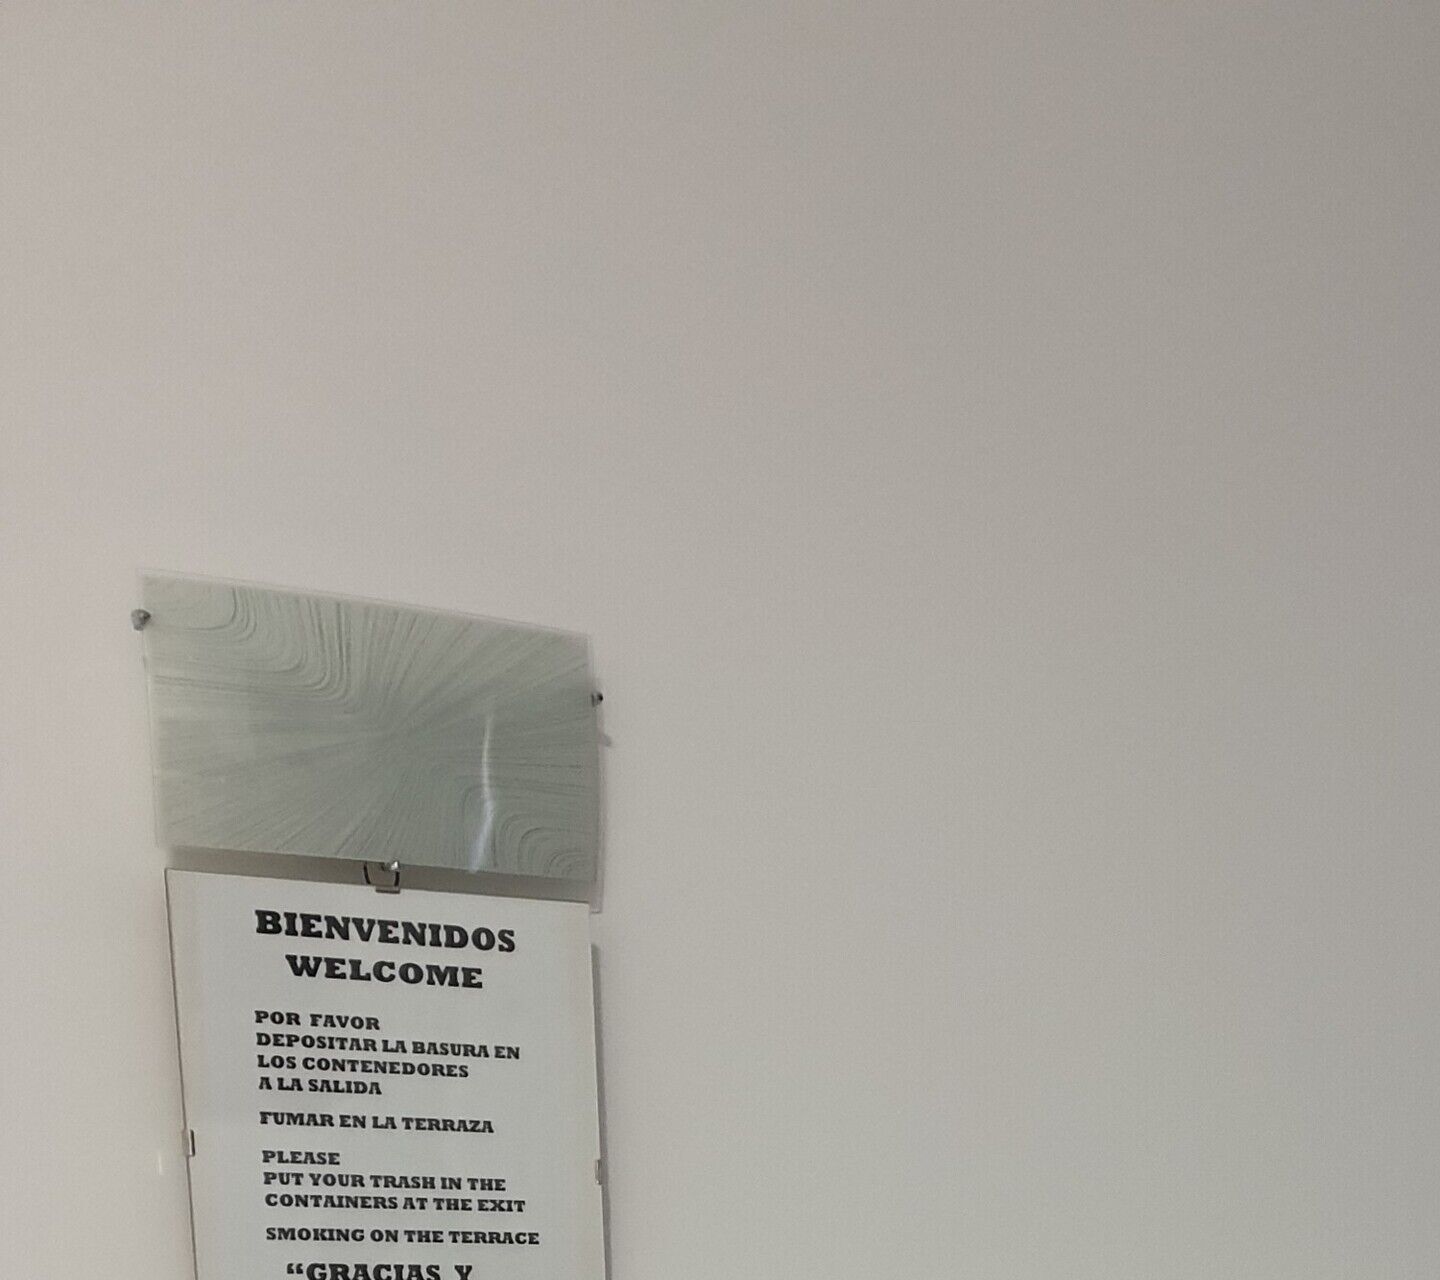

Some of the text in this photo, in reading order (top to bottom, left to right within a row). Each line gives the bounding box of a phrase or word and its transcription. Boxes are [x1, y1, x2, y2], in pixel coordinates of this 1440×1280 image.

[254, 909, 516, 953] BIENVENIDOS
[284, 953, 483, 990] WELCOME
[254, 1009, 381, 1031] POR FAVOR
[255, 1031, 521, 1060] DEPOSITAR LA BASURA EN
[256, 1054, 469, 1078] LOS CONTENEDORES
[258, 1076, 383, 1096] A LA SALIDA
[258, 1110, 495, 1134] FUMAR EN LA TERRAZA
[261, 1149, 341, 1166] PLEASE
[262, 1171, 507, 1192] PUT YOUR TRASH IN THE
[264, 1193, 526, 1213] CONTAINERS AT THE EXIT
[265, 1226, 540, 1246] SMOKING ON THE TERRACE
